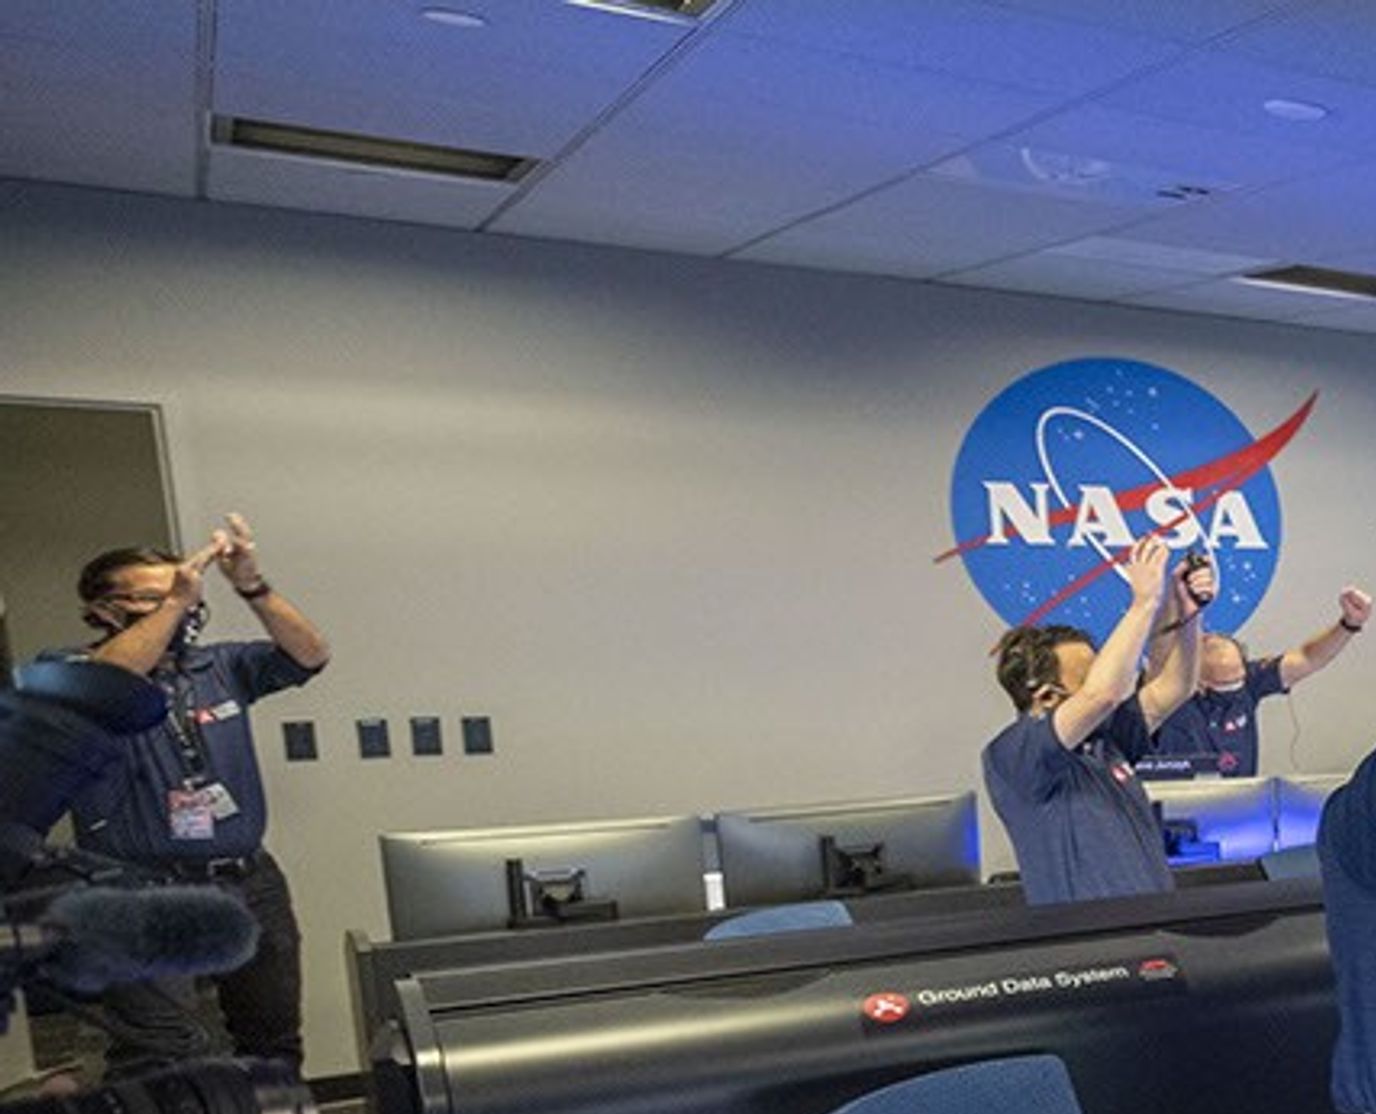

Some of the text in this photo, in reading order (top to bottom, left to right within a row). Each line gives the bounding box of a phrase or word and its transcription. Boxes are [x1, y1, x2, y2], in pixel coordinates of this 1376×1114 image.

[982, 480, 1269, 549] NASA
[918, 982, 998, 1005] Ground
[1002, 976, 1052, 994] Data
[1054, 966, 1129, 987] System
